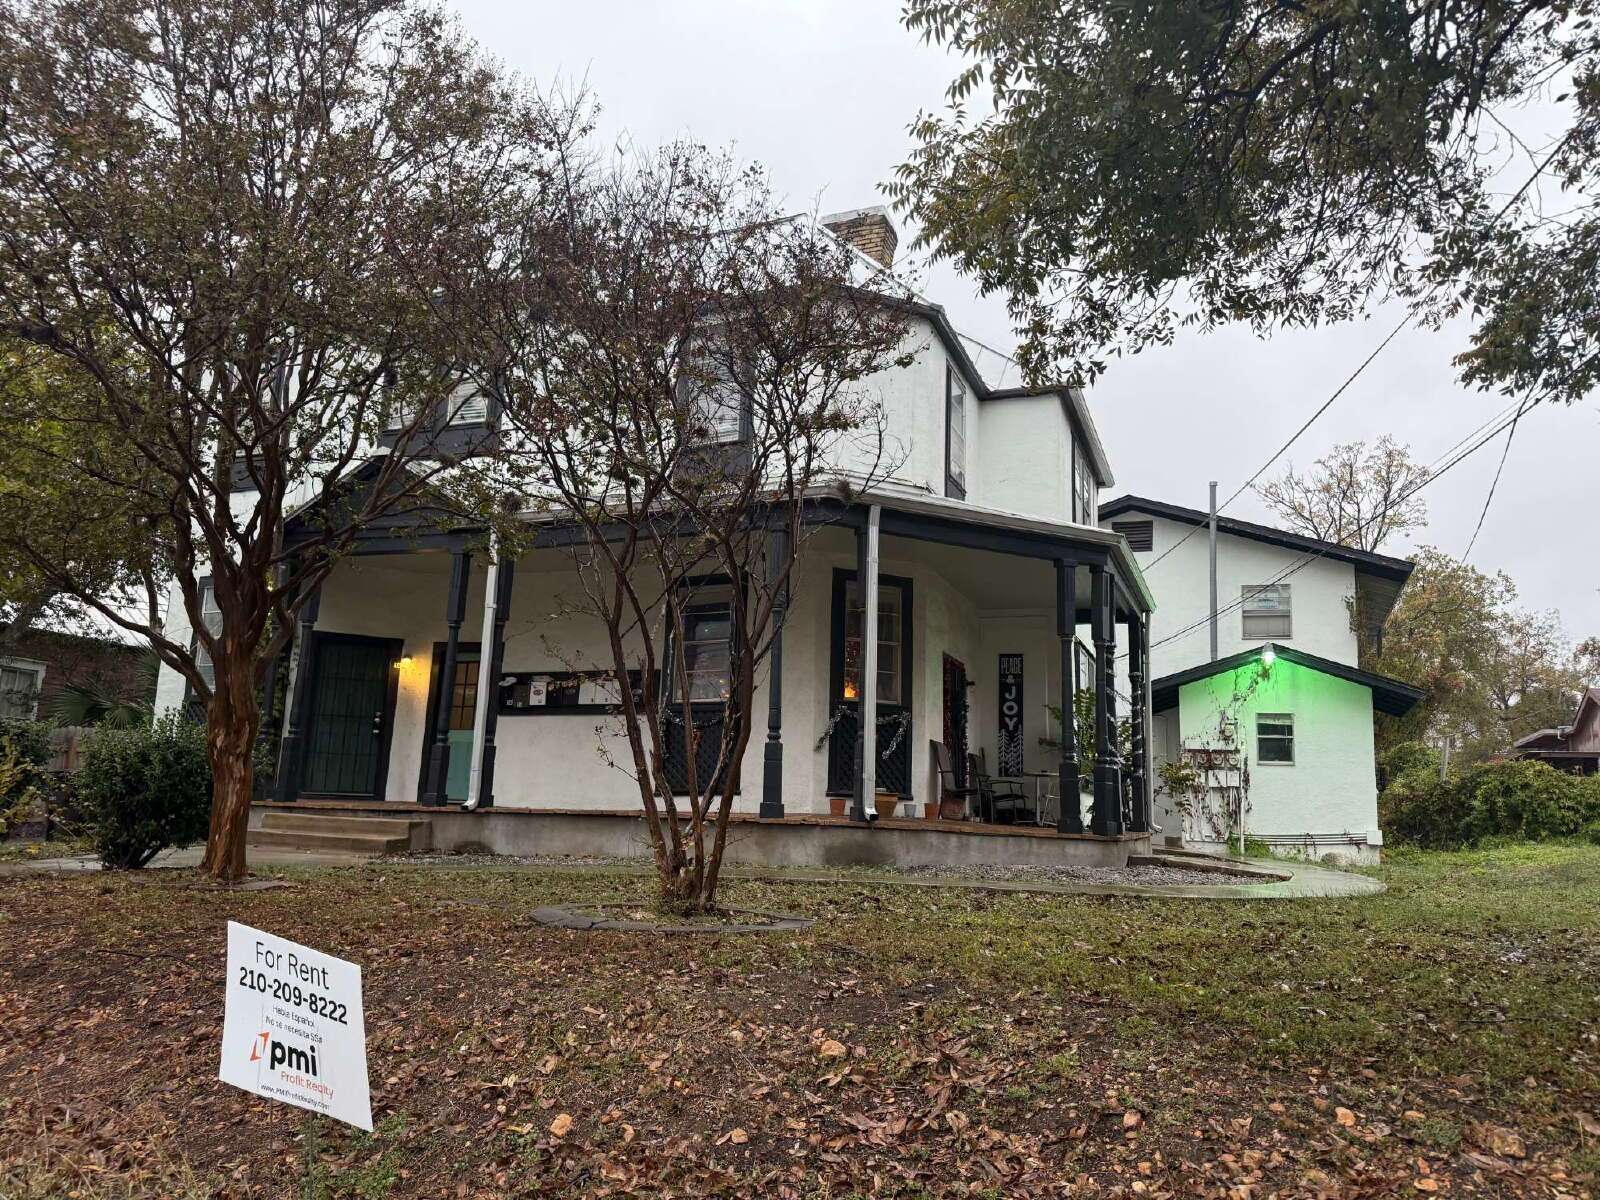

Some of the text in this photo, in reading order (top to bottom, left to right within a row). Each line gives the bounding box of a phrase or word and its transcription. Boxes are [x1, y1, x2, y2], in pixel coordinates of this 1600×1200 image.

[1001, 657, 1022, 674] PEACE
[1003, 686, 1018, 730] JOY
[256, 941, 330, 990] For Rent
[239, 966, 348, 1025] 210-209-8222
[270, 1040, 317, 1076] pmi
[281, 1071, 334, 1099] Profit Realty
